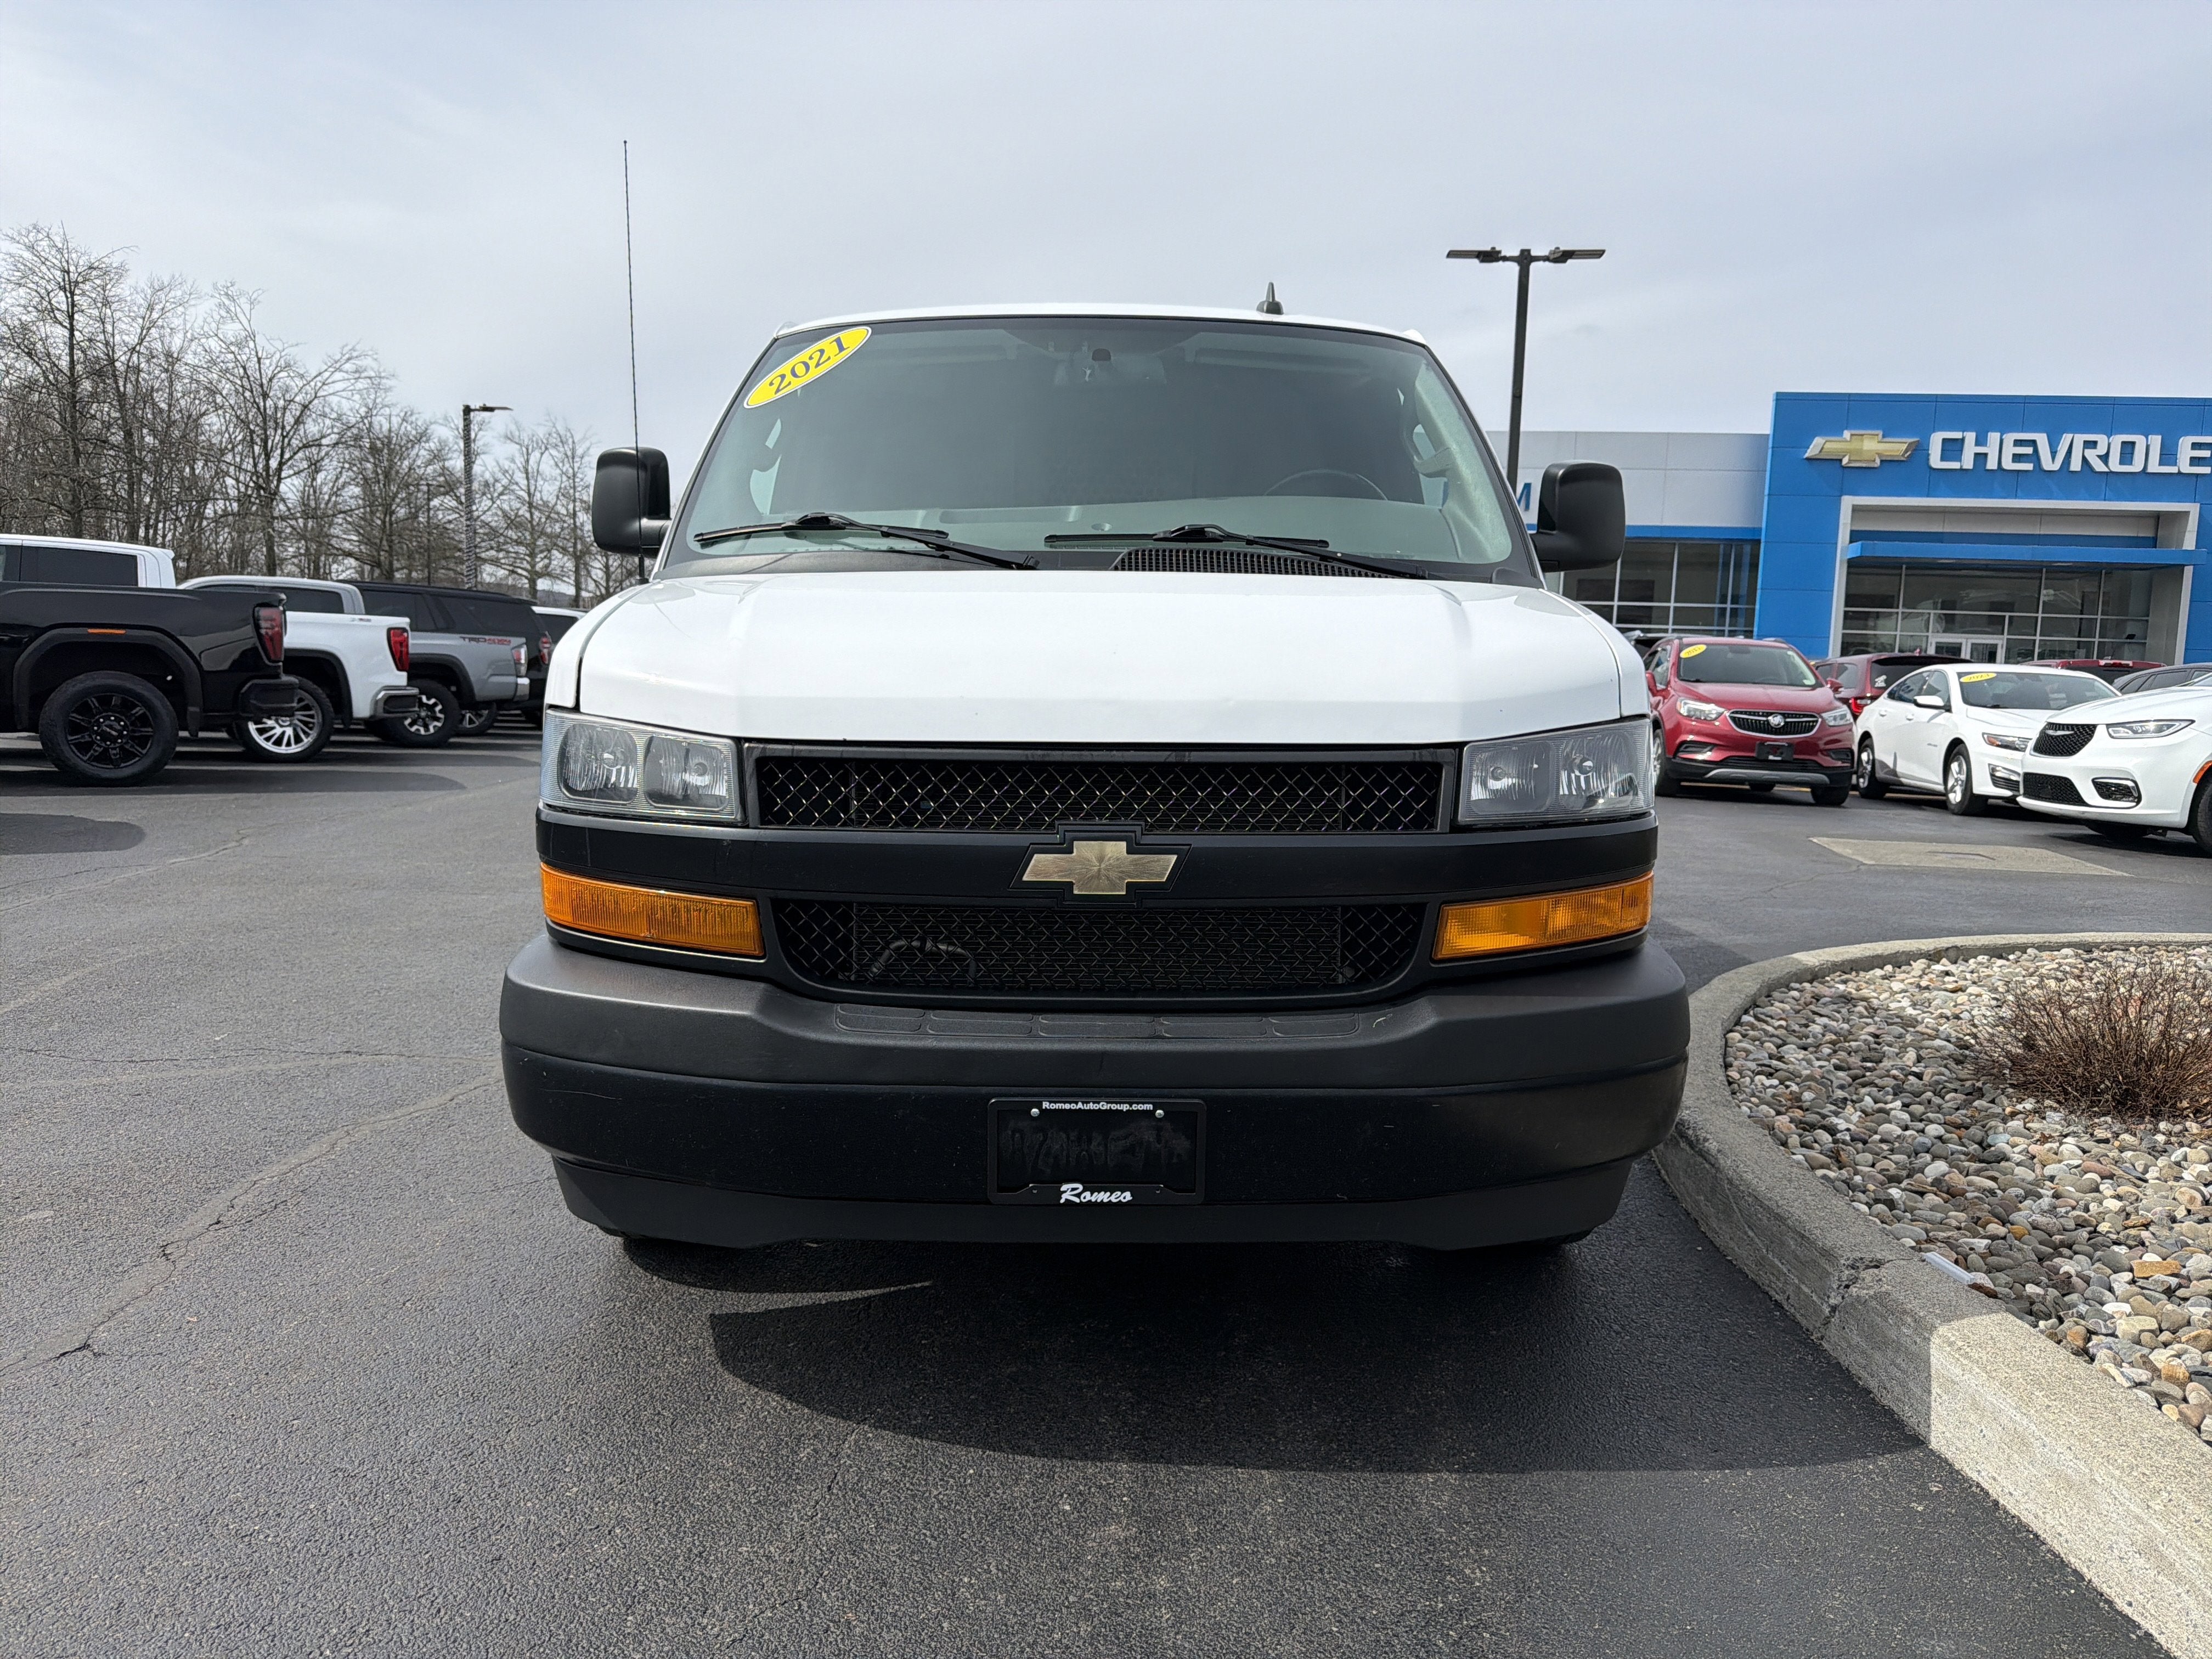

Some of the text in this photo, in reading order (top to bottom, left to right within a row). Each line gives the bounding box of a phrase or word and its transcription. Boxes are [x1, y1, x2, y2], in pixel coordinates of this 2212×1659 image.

[769, 336, 850, 395] 2021
[1929, 431, 2211, 474] CHEVROLE
[1042, 1101, 1153, 1111] RomeoAutoGroup.com
[1059, 1183, 1133, 1204] Romeo
